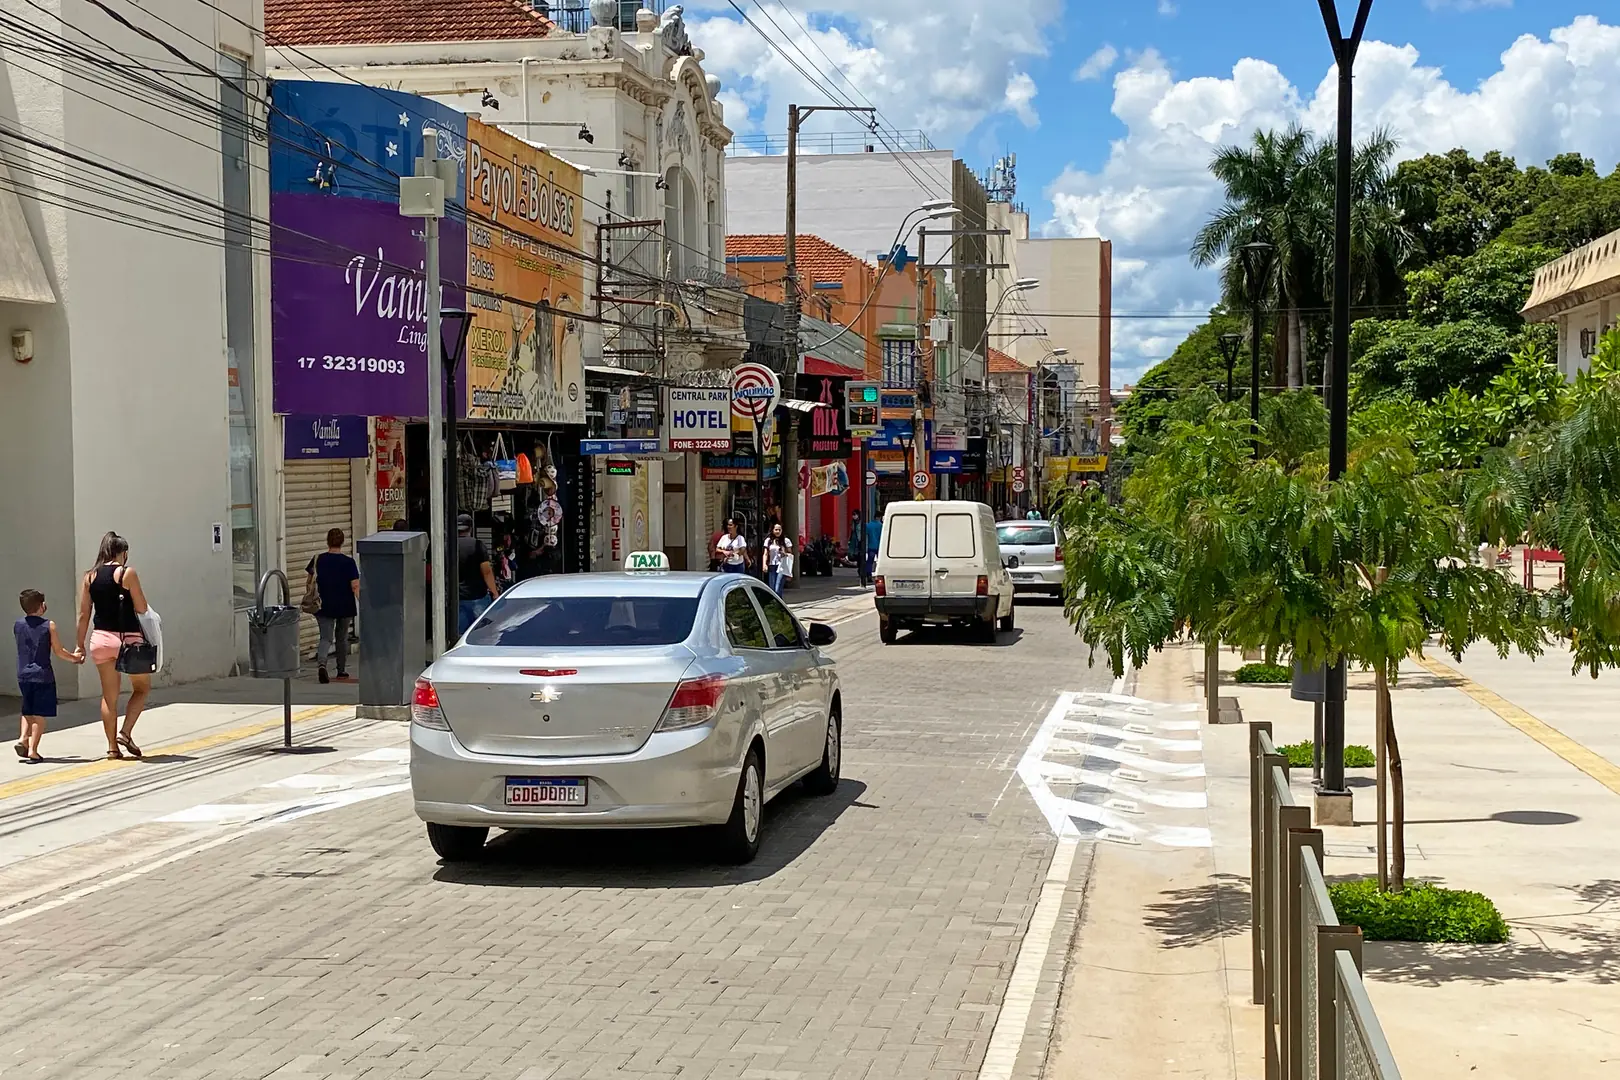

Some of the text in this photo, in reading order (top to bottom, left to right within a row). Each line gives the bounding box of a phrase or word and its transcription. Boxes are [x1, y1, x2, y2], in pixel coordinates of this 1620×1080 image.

[470, 139, 517, 221] Payol
[529, 165, 575, 237] Bolsas
[471, 251, 495, 281] Bolsas
[471, 326, 507, 353] XEROX
[297, 355, 405, 375] 17 32319093
[671, 391, 728, 401] CENTRAL PARK
[312, 418, 340, 440] Vanilla
[673, 410, 728, 429] HOTEL
[813, 409, 839, 436] MIX
[673, 441, 695, 449] FONE:
[695, 440, 730, 449] 3222-4550
[915, 474, 926, 484] 20
[1013, 481, 1022, 489] 20
[379, 488, 405, 502] XEROX
[611, 505, 621, 562] HOTEL
[631, 554, 662, 568] TAXI
